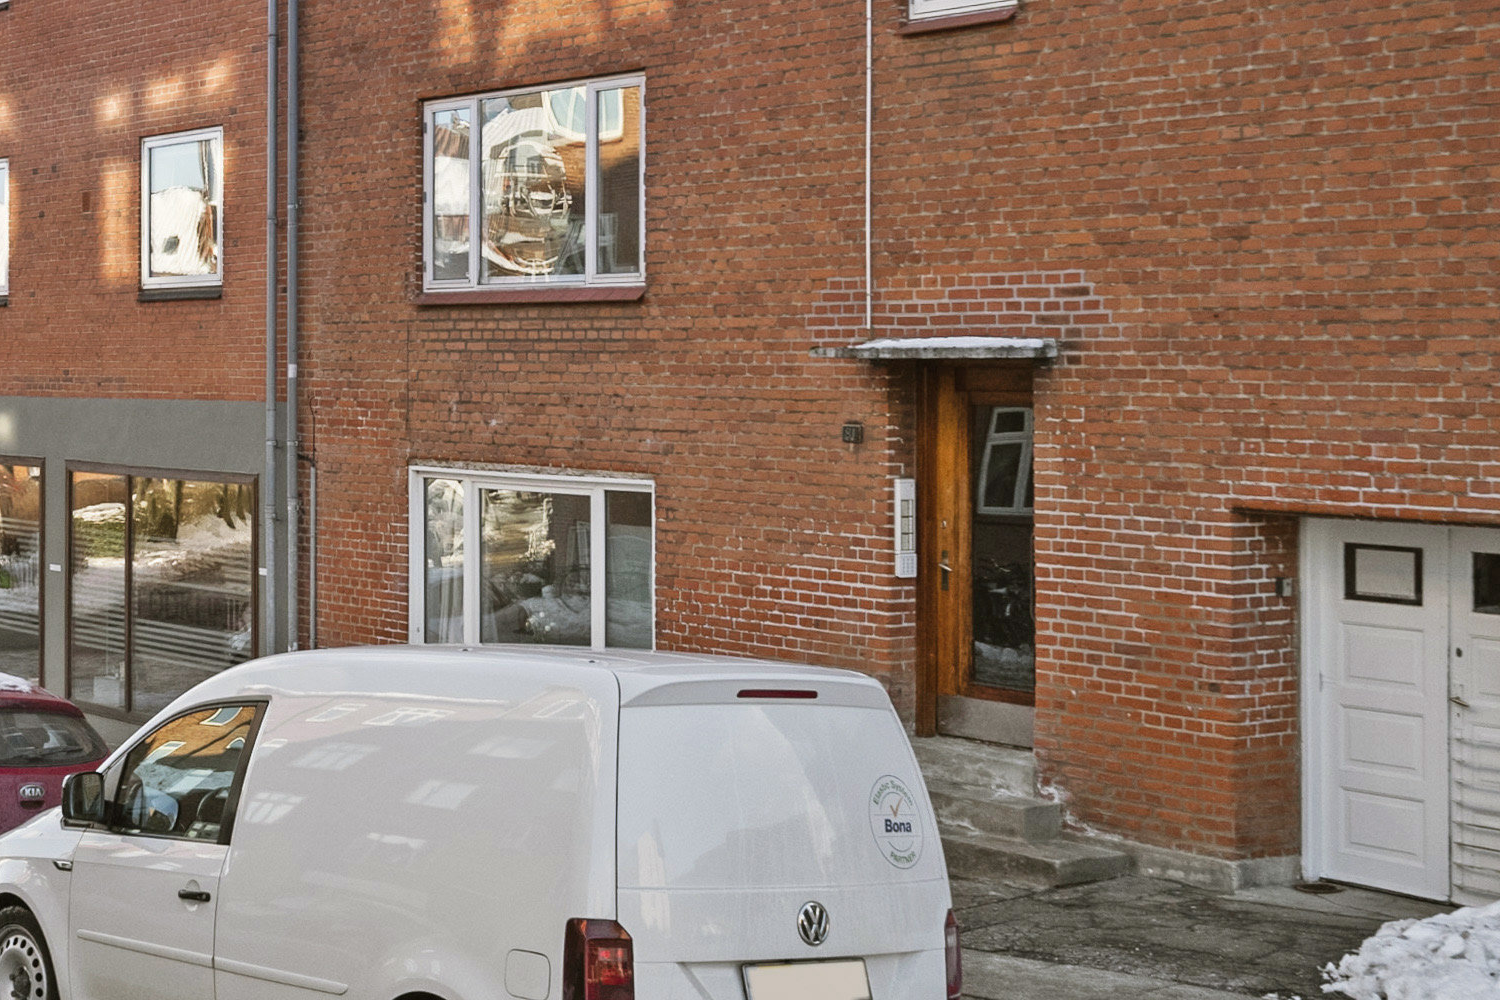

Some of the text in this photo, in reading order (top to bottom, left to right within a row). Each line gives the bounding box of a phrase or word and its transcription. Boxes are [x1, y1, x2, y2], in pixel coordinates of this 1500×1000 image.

[24, 787, 42, 797] KIA
[885, 818, 912, 833] Bona
[890, 850, 916, 864] PARTNER
